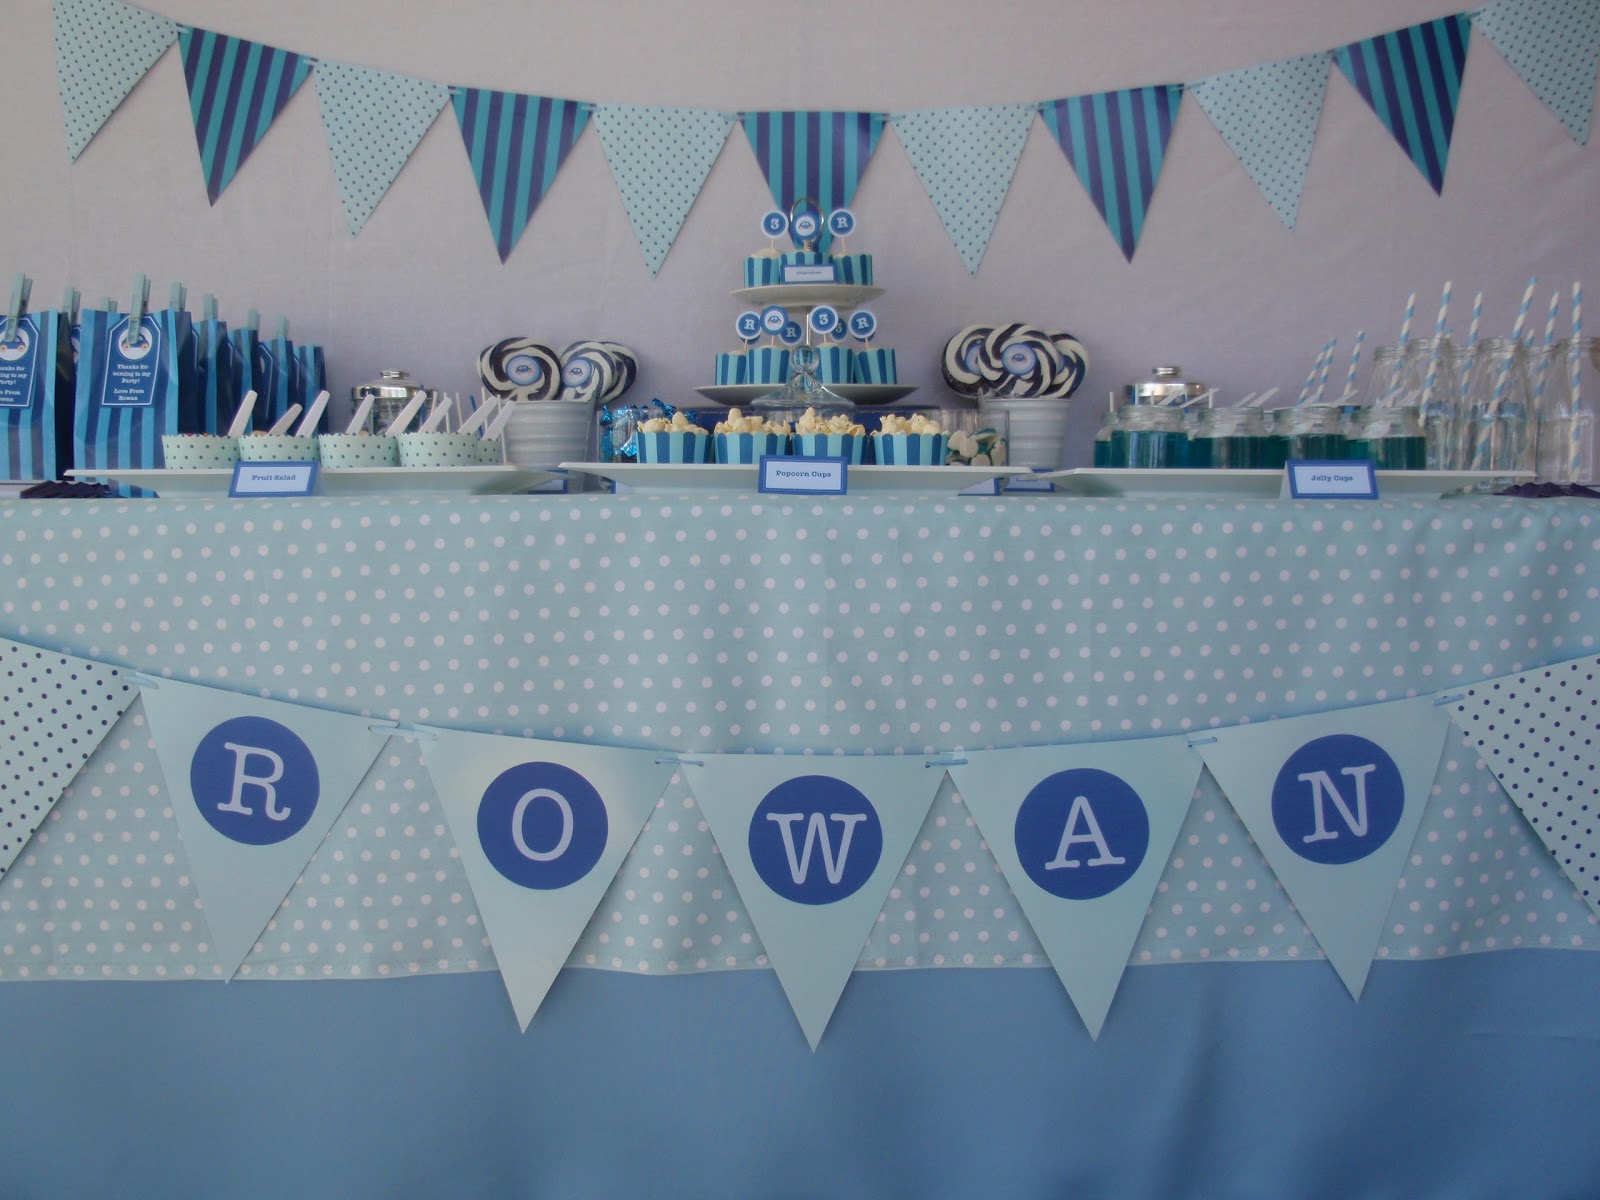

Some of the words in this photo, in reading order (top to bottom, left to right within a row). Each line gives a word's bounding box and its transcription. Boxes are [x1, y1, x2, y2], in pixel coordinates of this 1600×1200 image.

[770, 218, 780, 230] 3
[836, 217, 849, 229] R
[743, 319, 755, 331] R
[819, 313, 829, 325] 3
[856, 317, 869, 329] R
[785, 327, 797, 338] R
[775, 470, 810, 478] Popcorn
[811, 471, 832, 479] Cups
